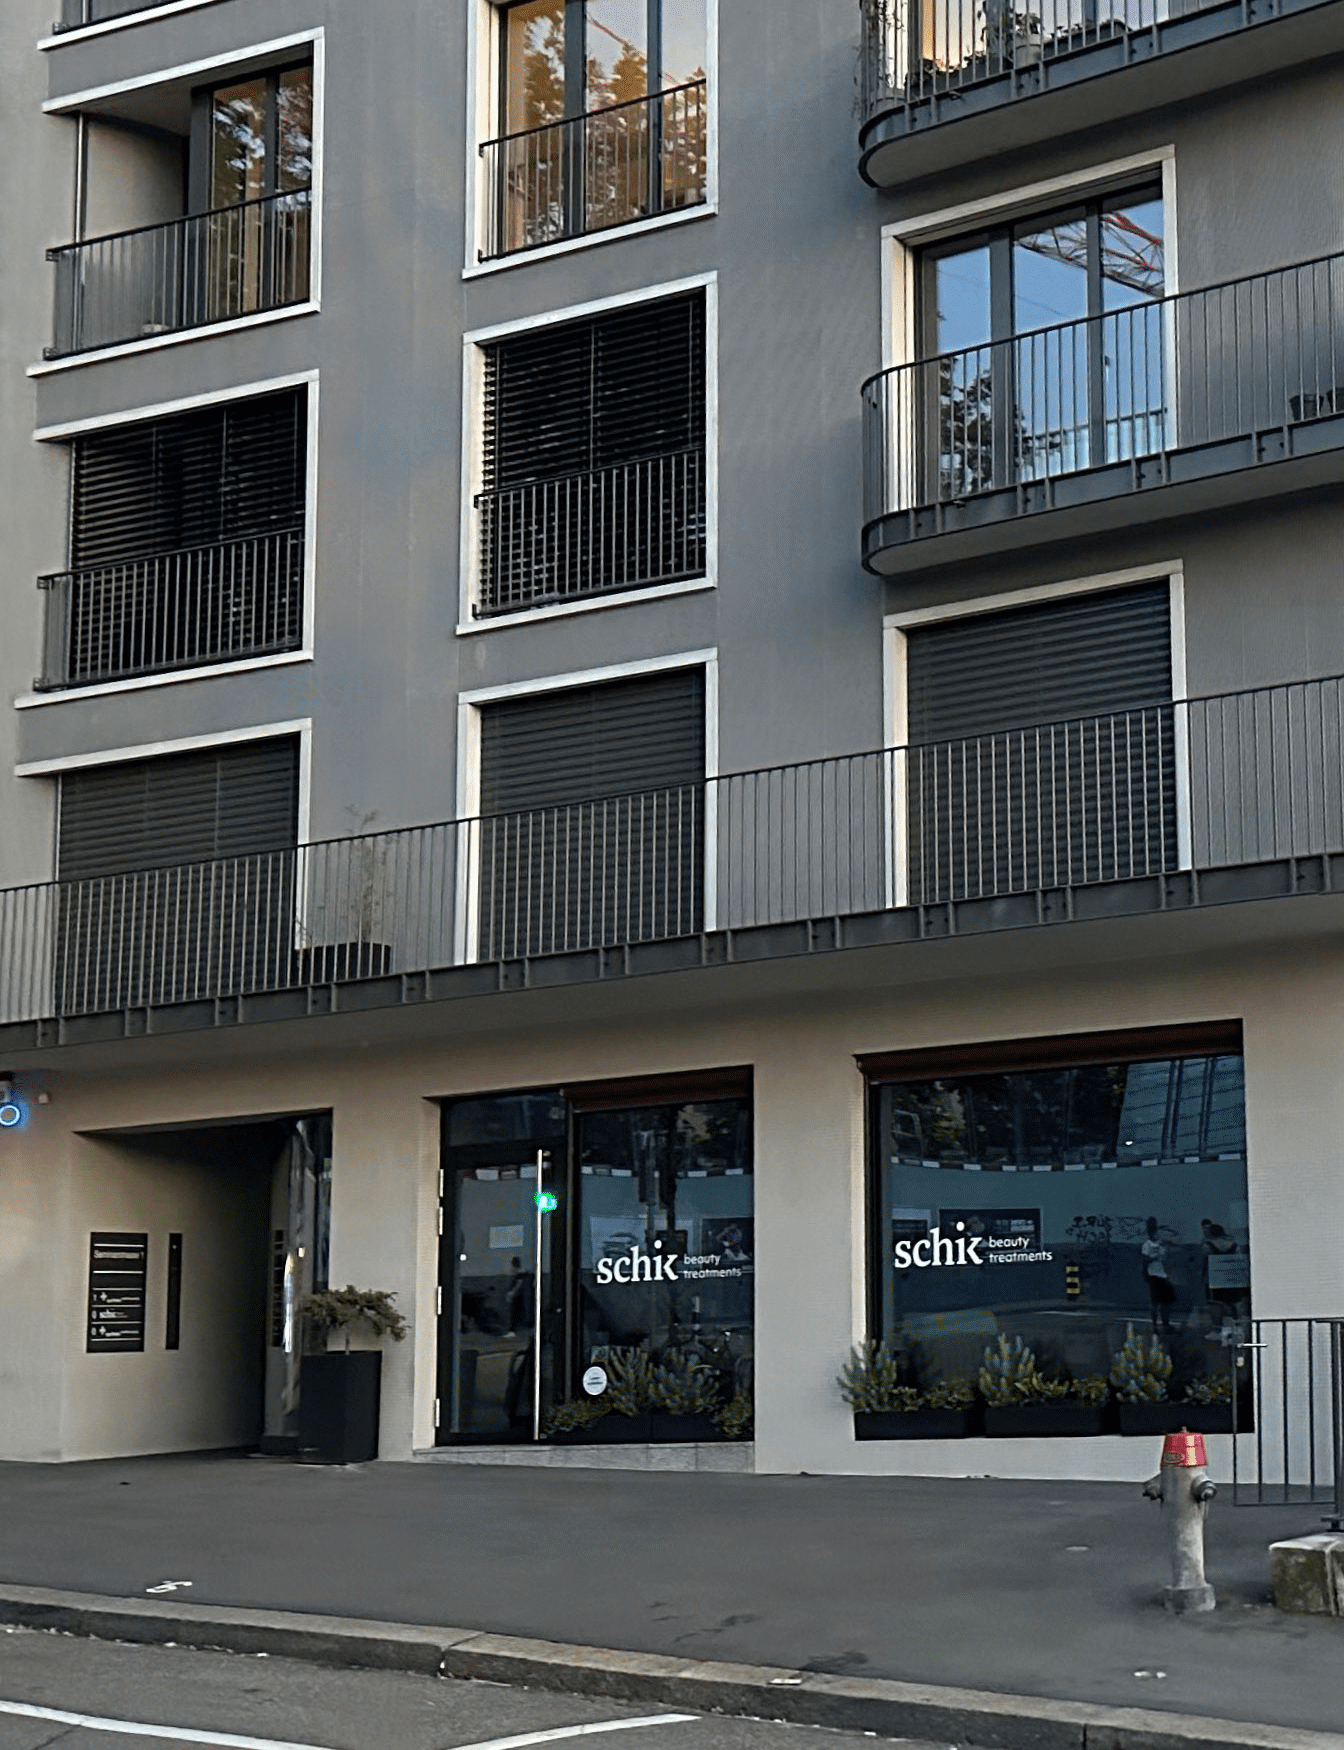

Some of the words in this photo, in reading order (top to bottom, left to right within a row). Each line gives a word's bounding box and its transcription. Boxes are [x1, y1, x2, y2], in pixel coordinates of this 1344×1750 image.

[894, 1221, 984, 1268] schik
[988, 1236, 1030, 1248] beauty
[596, 1240, 679, 1284] schik
[683, 1254, 721, 1266] beauty
[989, 1251, 1053, 1263] treatments
[684, 1268, 742, 1279] treatments
